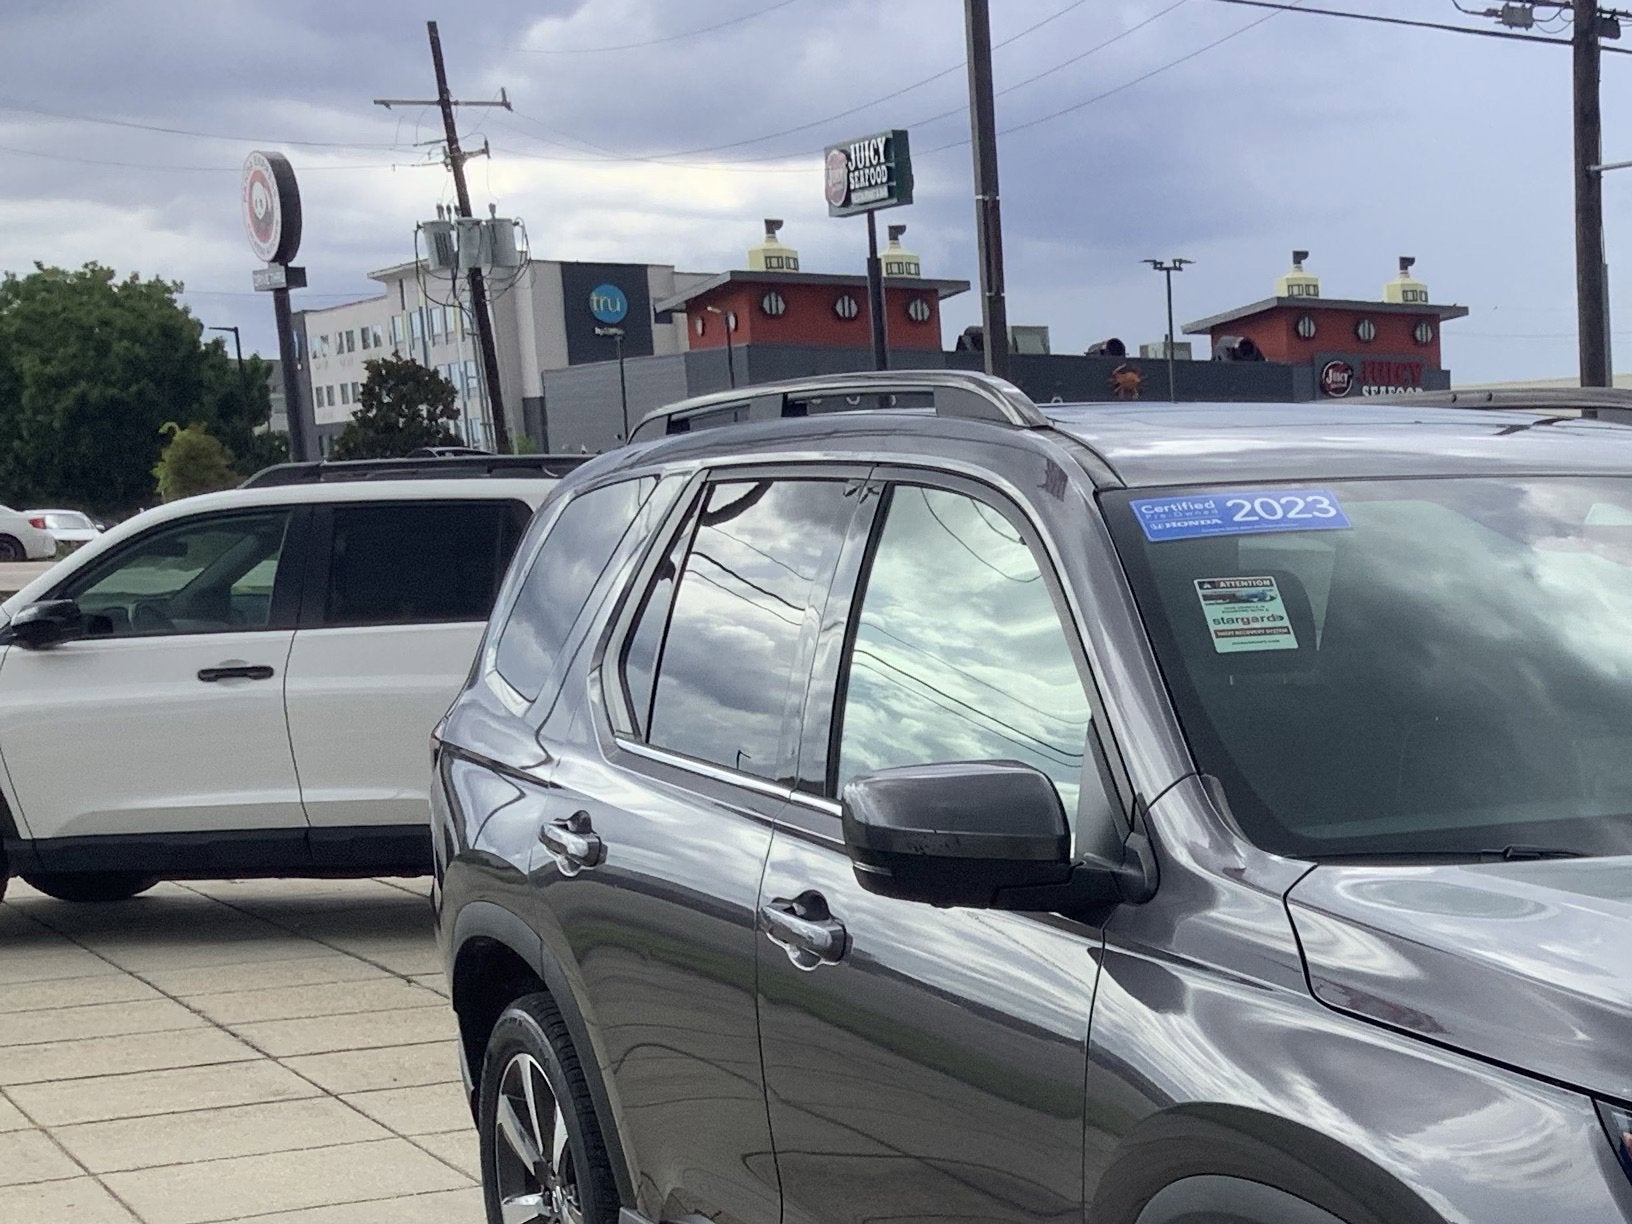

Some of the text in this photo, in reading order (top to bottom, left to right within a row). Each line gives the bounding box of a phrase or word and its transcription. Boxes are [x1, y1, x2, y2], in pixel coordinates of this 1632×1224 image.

[848, 136, 886, 171] JUICY
[849, 165, 888, 190] SEAFOOD
[591, 291, 621, 312] tru
[1141, 495, 1337, 522] Certified 2023
[1164, 518, 1223, 528] HONDA
[1219, 579, 1271, 588] ATTENTION
